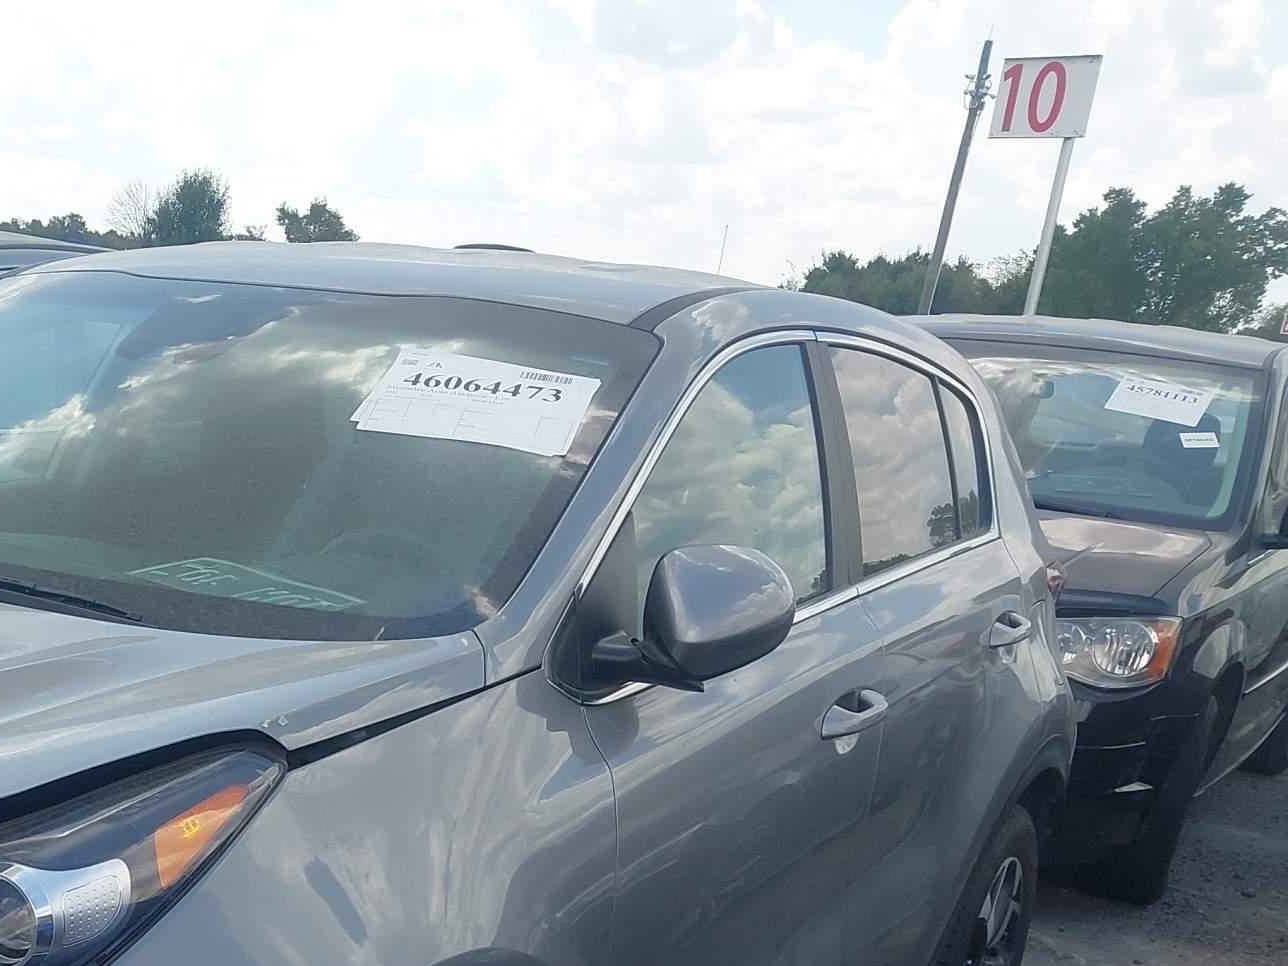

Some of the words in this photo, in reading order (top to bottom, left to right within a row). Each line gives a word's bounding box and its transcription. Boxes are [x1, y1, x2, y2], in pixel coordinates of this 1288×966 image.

[1002, 61, 1067, 134] 10
[403, 372, 563, 402] 46064473
[1126, 385, 1199, 404] 45781113
